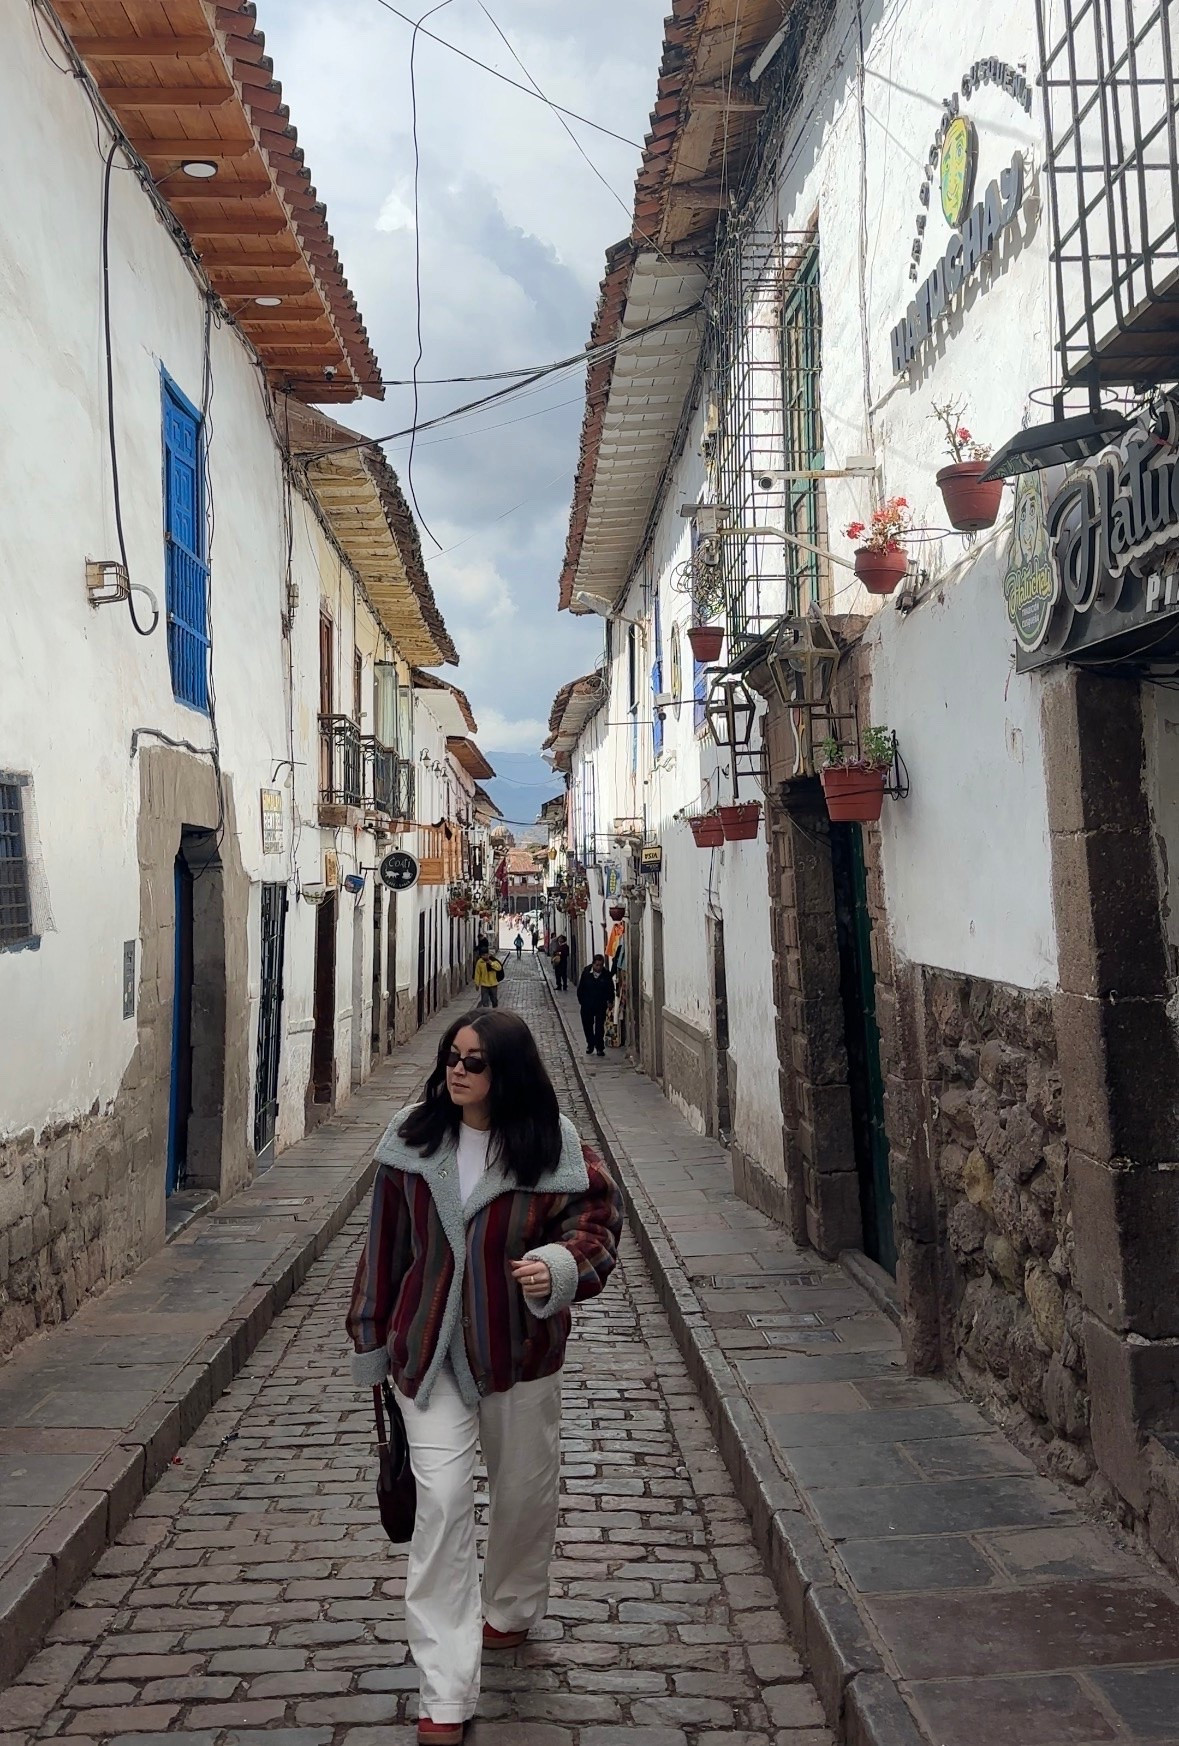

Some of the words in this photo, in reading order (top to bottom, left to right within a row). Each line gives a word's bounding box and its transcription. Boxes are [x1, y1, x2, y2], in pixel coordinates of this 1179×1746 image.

[890, 150, 1025, 376] HATUCHAY
[1047, 410, 1179, 606] Hatu
[1005, 561, 1053, 616] Hatuchay
[1145, 572, 1179, 613] PI
[645, 852, 658, 860] VISA
